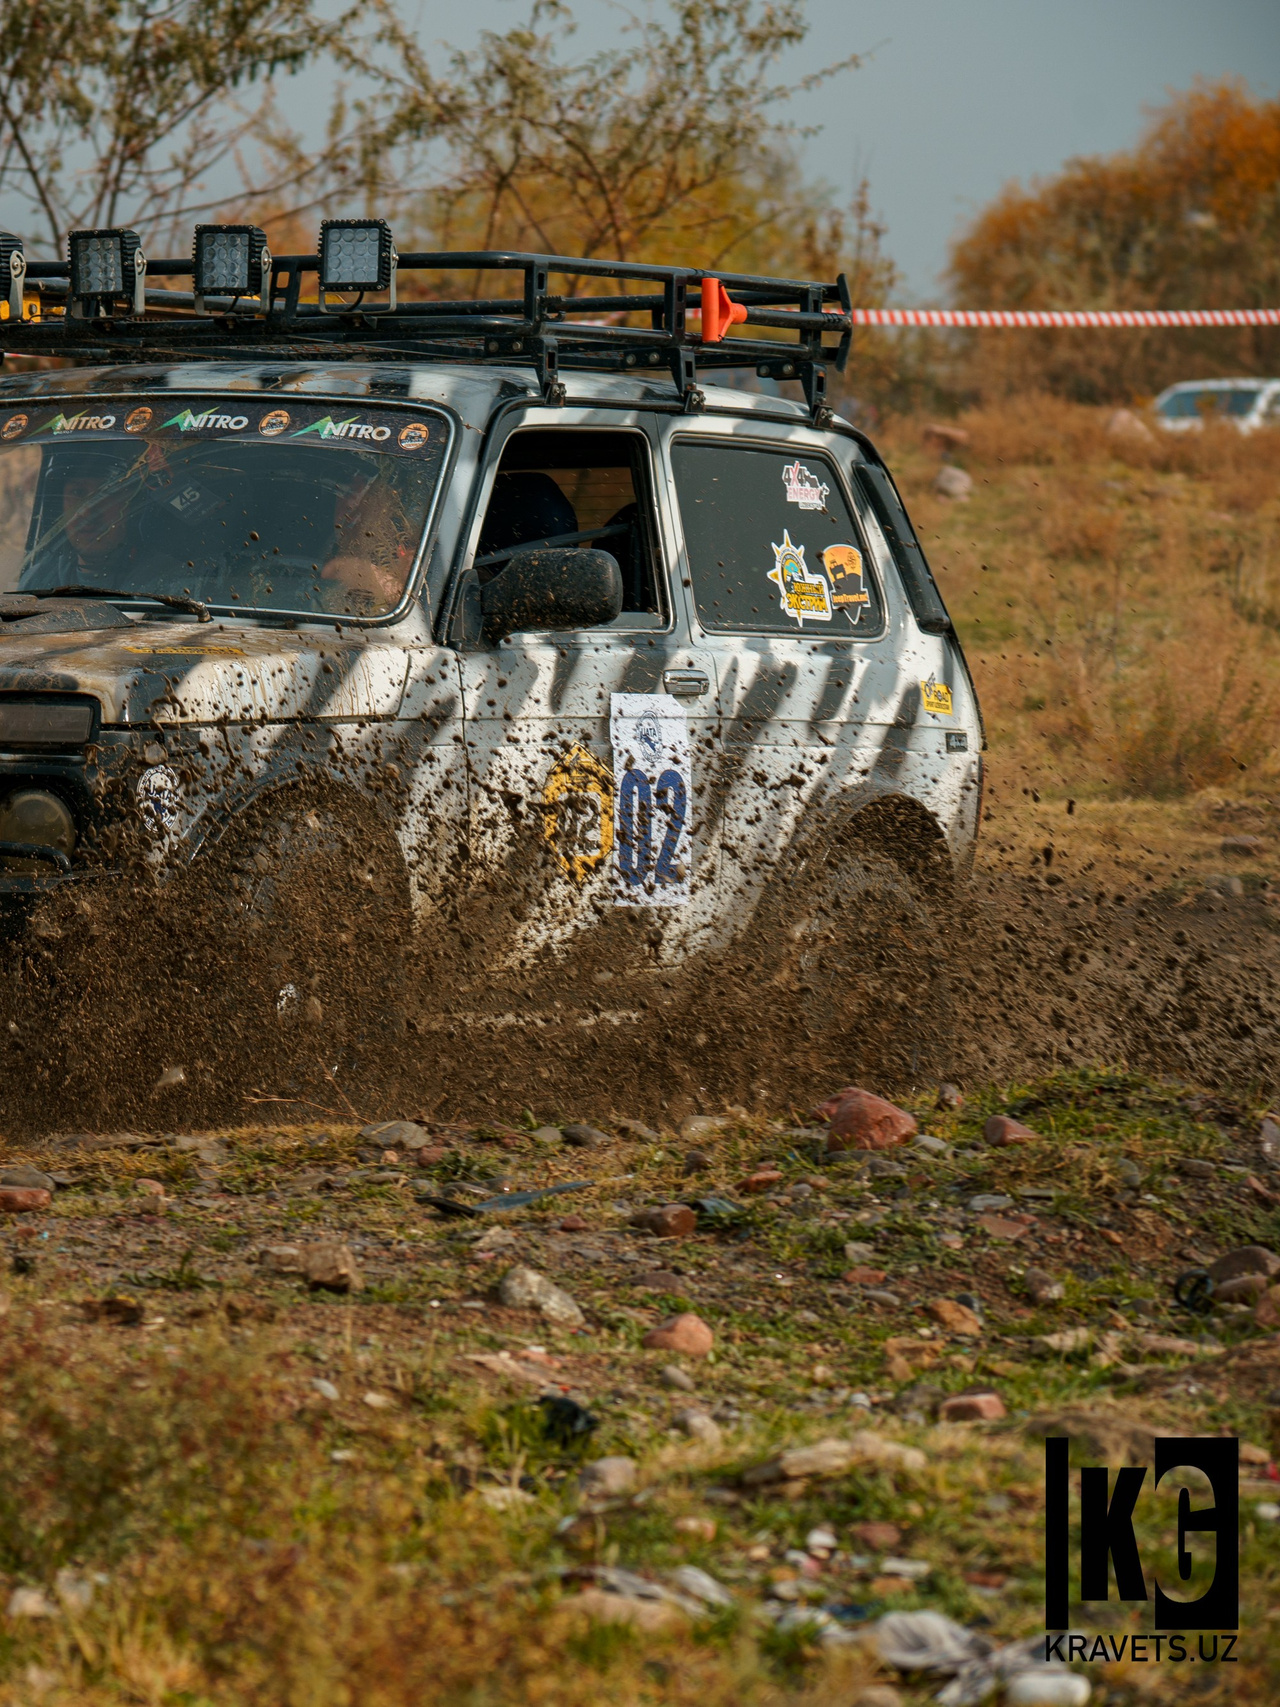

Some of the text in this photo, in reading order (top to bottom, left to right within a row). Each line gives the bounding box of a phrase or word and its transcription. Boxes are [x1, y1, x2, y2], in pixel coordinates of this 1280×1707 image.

[55, 415, 116, 431] NITRO
[183, 412, 249, 430] NITRO
[323, 421, 391, 441] NITRO
[788, 487, 820, 501] ENERGY
[620, 769, 687, 886] 02
